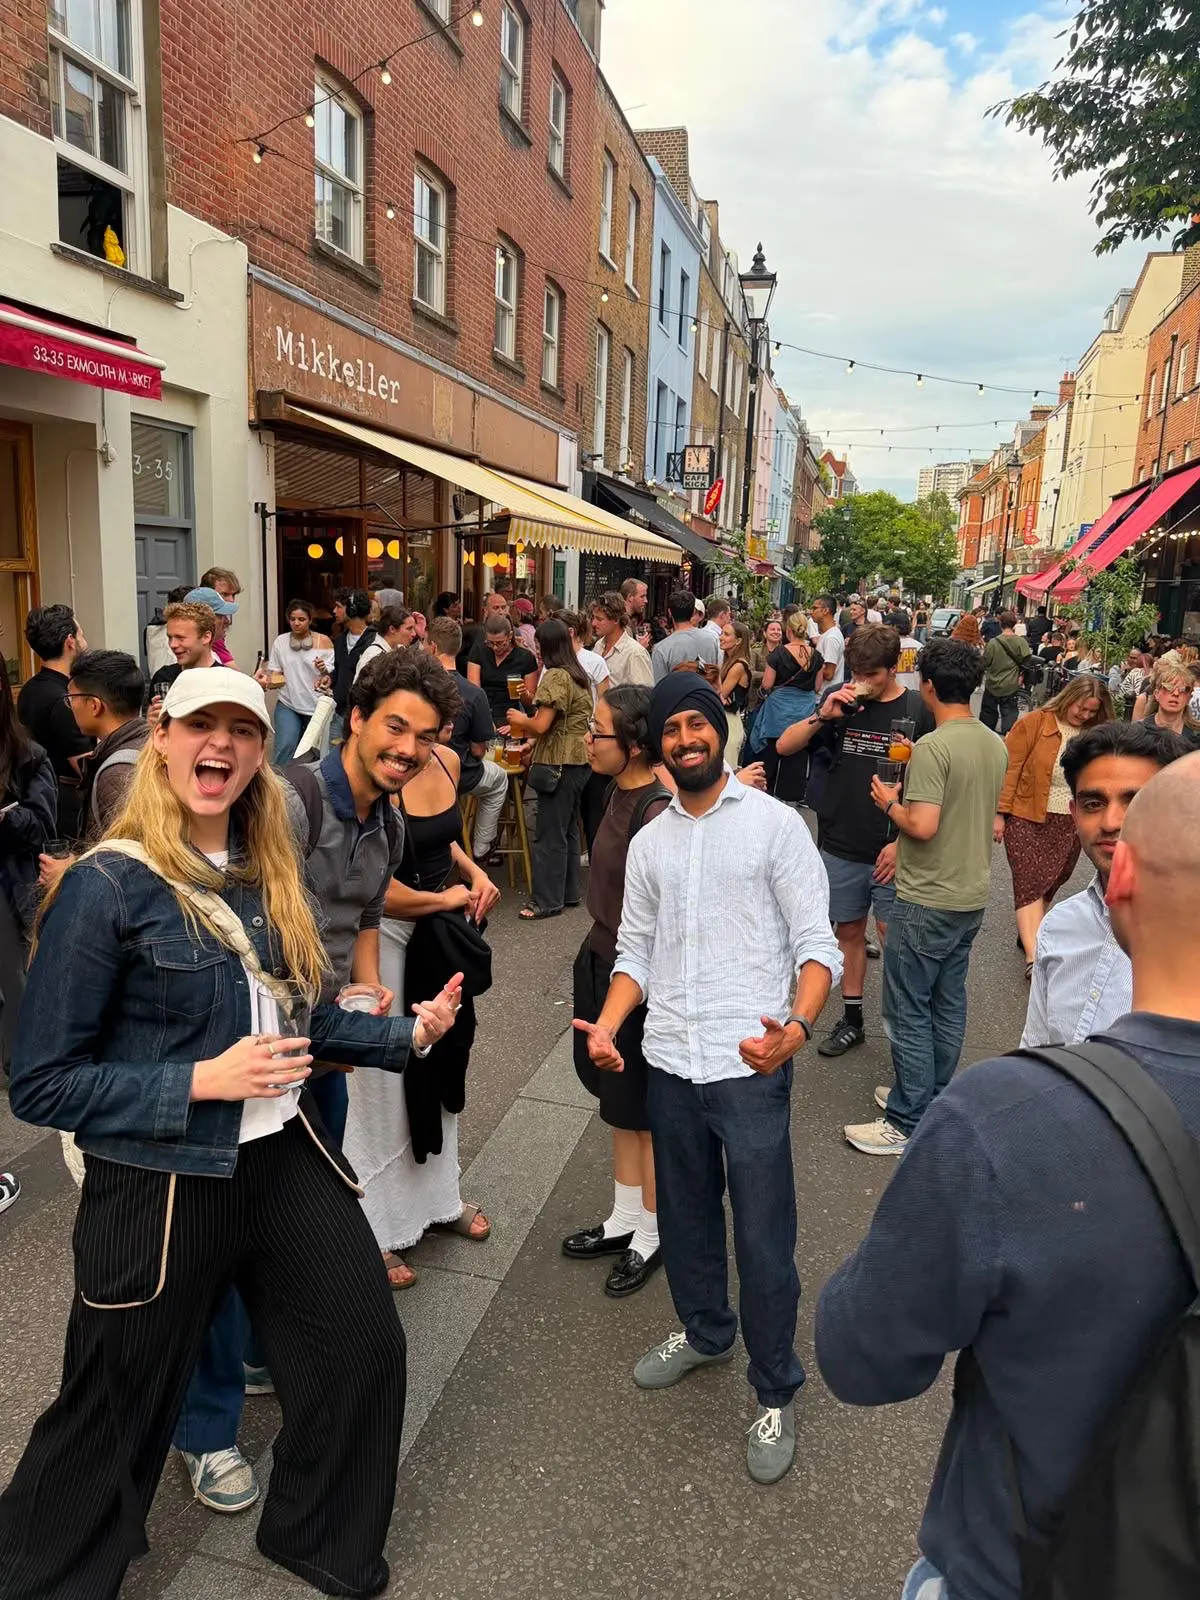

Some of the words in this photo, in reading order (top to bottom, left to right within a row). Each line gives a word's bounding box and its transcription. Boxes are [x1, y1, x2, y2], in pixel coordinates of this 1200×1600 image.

[33, 345, 64, 367] 33-35
[67, 354, 116, 381] EXMOUTH
[276, 326, 400, 404] Mikkeller
